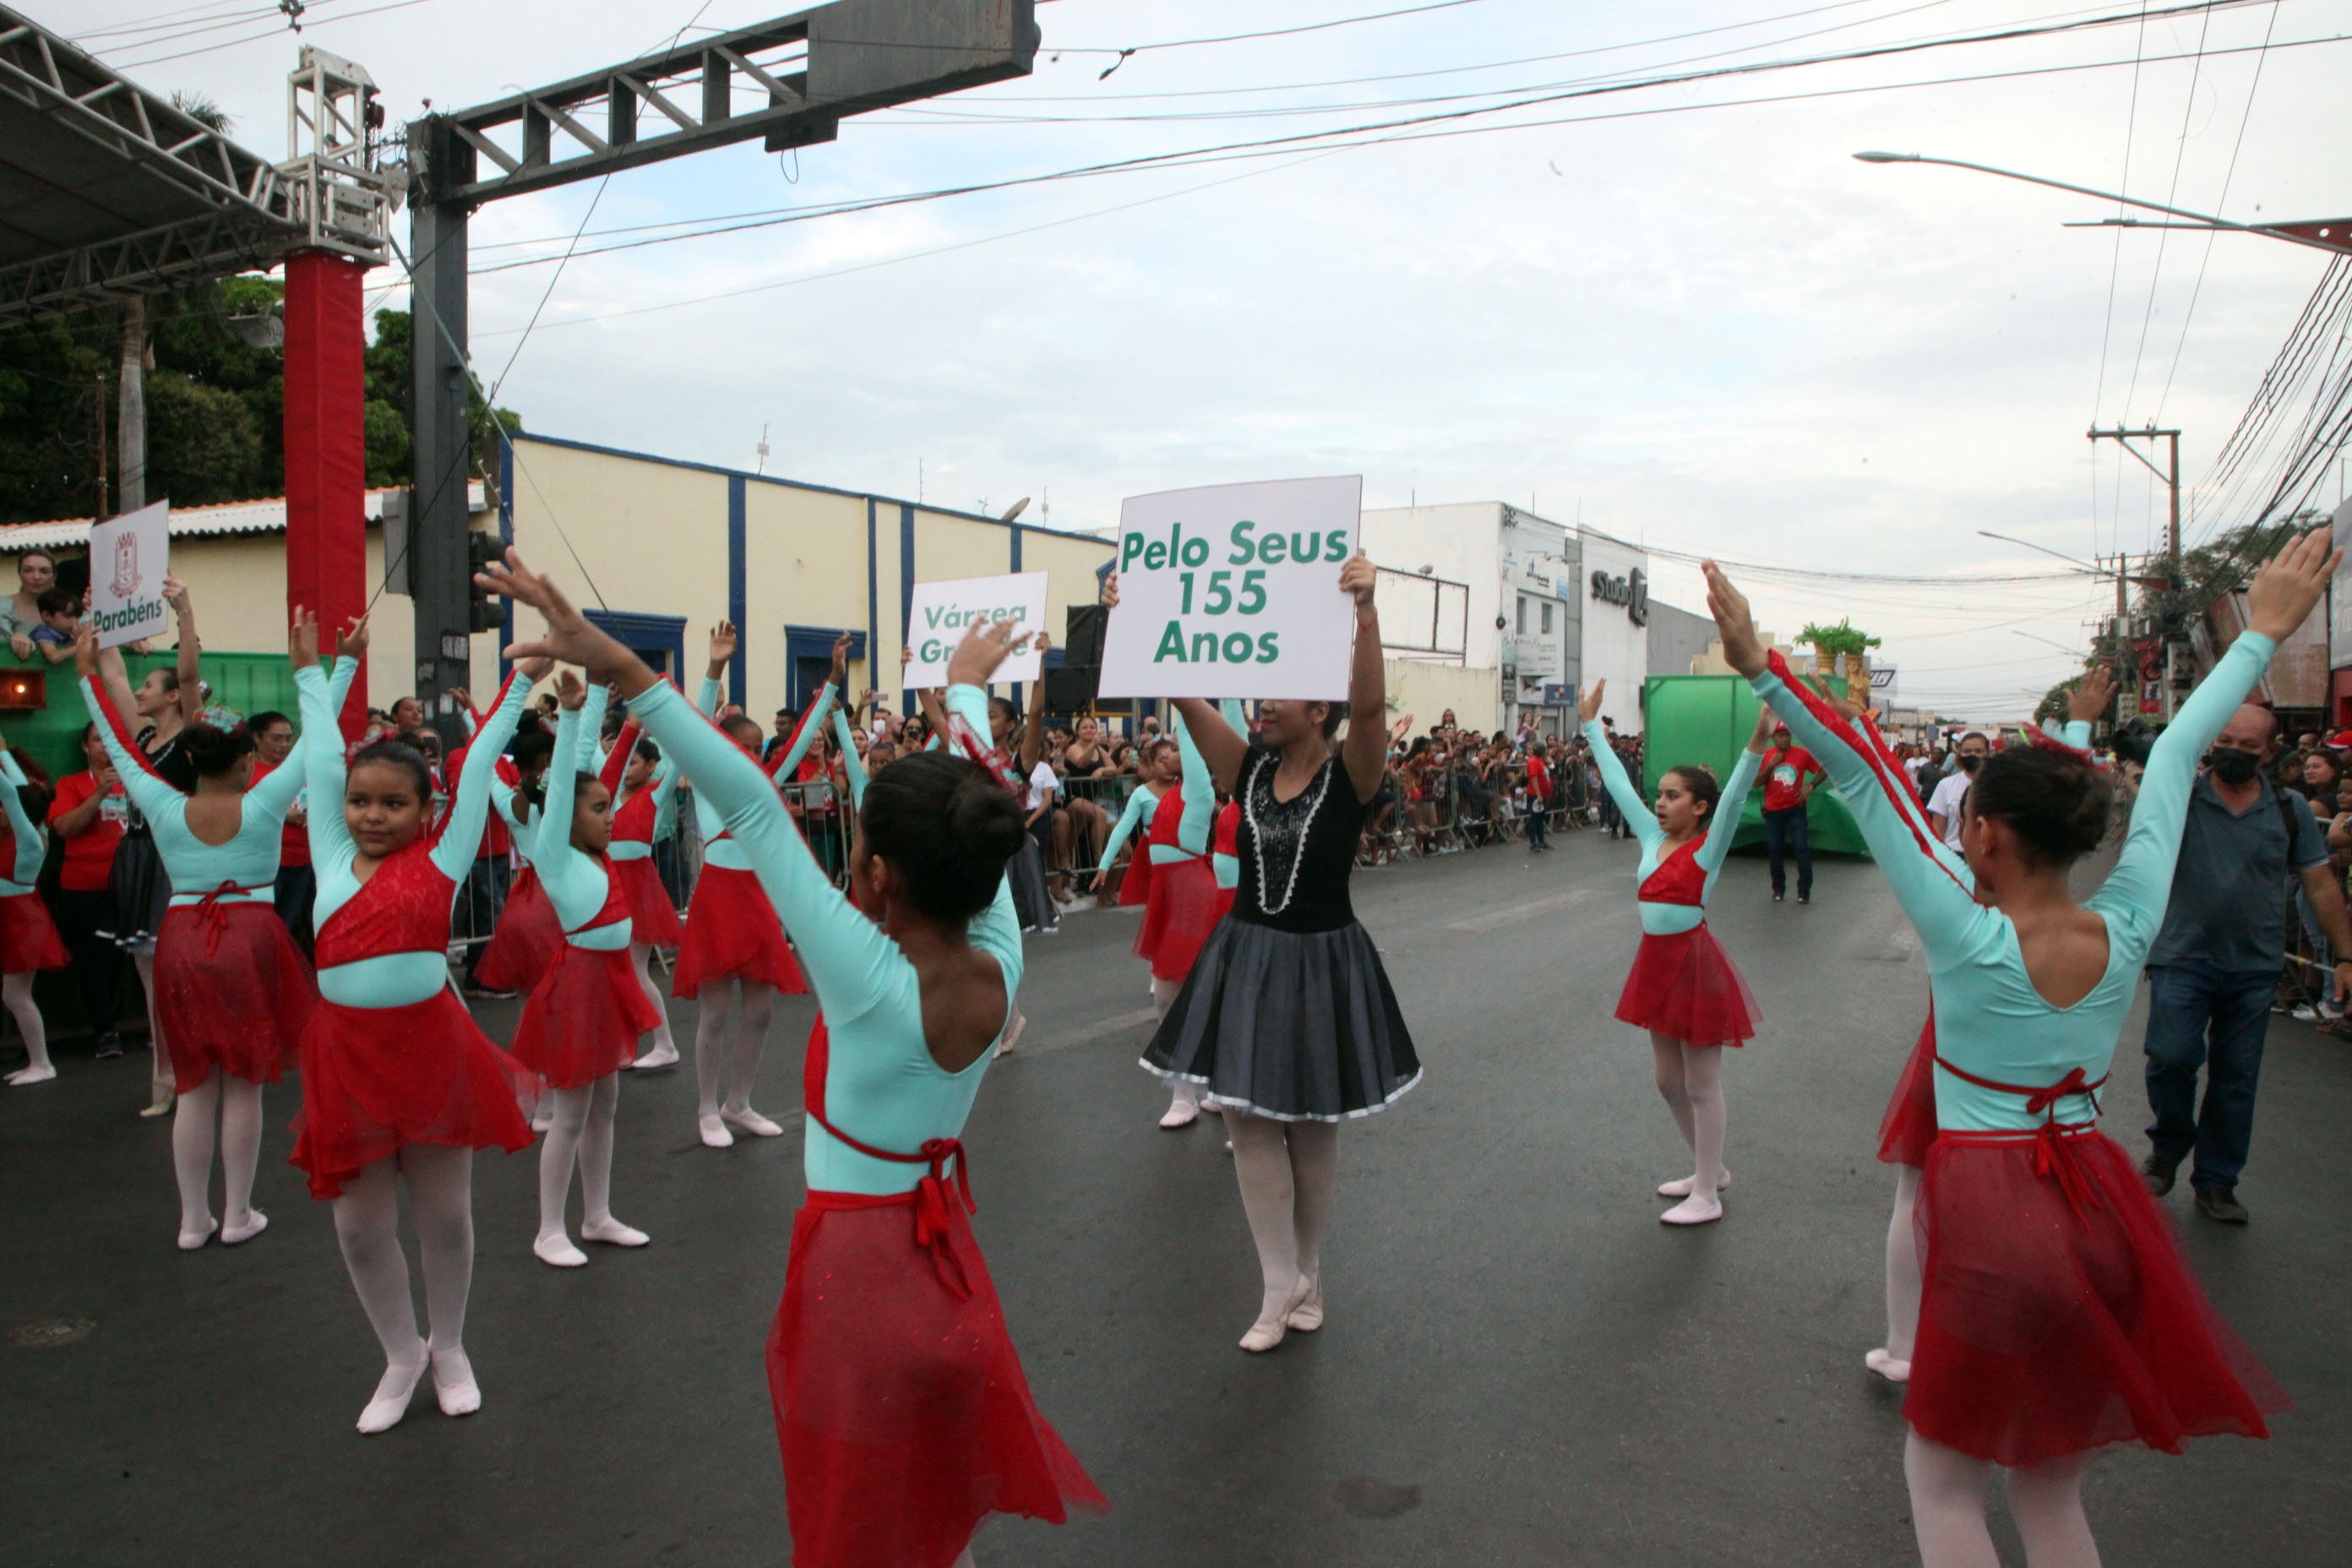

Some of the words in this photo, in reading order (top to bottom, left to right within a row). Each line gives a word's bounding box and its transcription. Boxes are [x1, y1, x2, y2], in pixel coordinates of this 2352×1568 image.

[1121, 522, 1210, 574] Pelo
[1228, 520, 1348, 565] Seus
[1179, 569, 1267, 615] 155
[93, 596, 162, 632] Parabéns
[920, 630, 1028, 663] Gre
[1153, 620, 1279, 663] Anos
